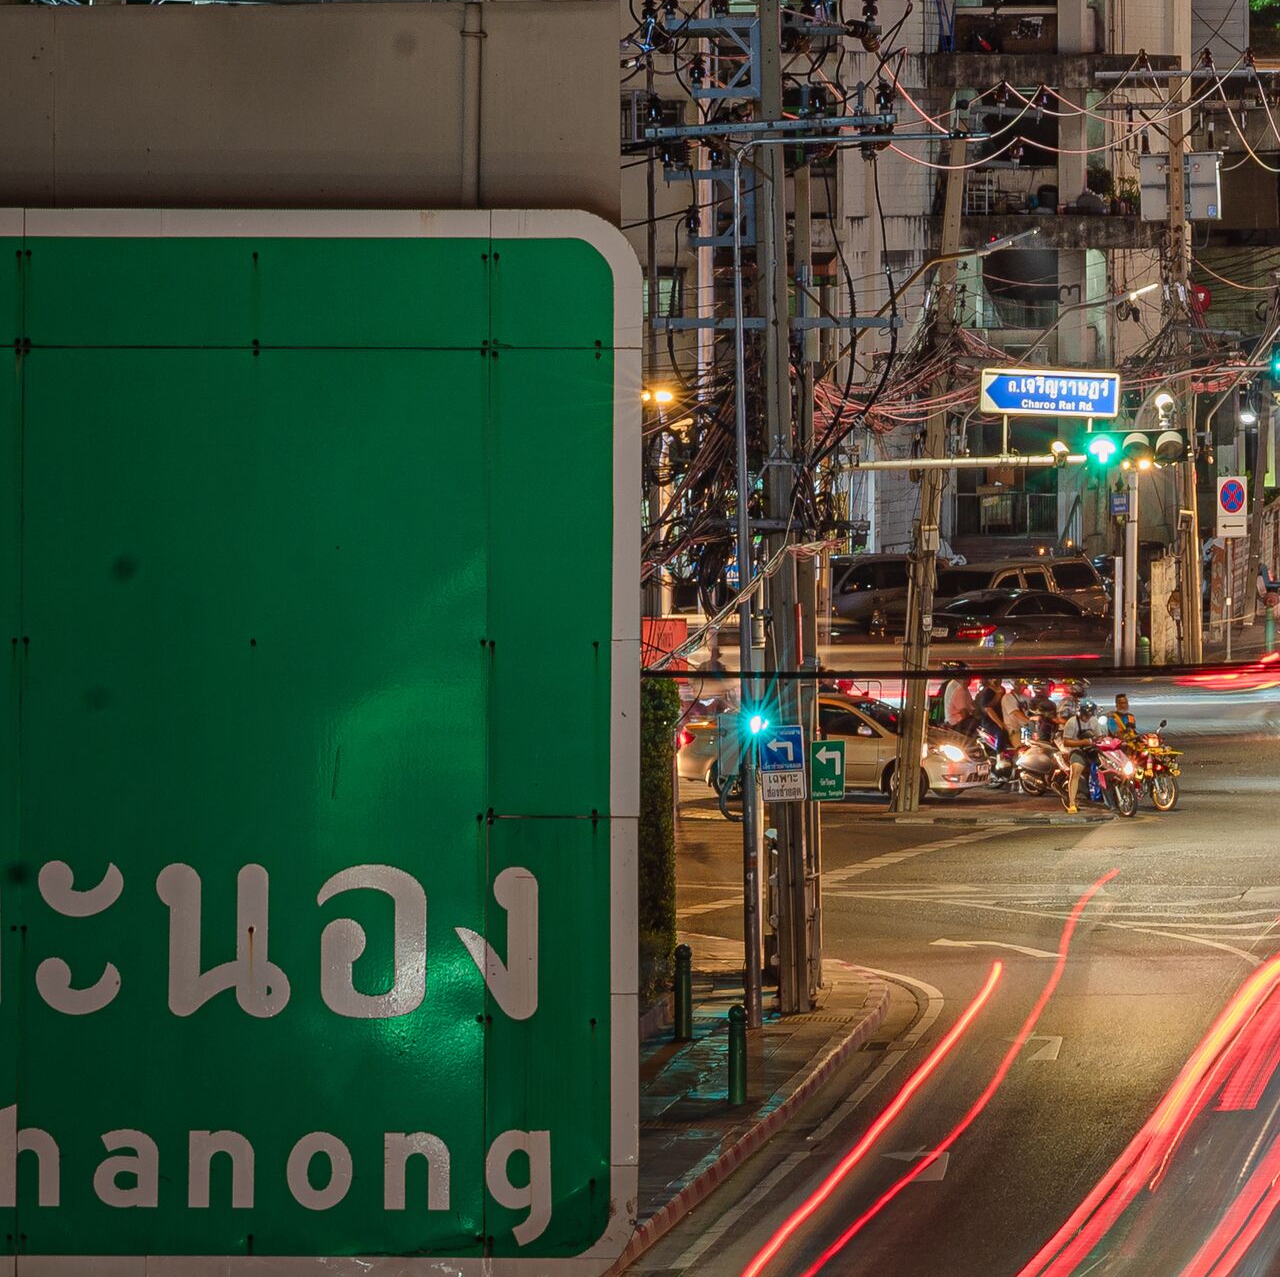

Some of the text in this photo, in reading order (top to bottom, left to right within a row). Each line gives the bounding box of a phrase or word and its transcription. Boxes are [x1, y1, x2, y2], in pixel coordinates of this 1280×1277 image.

[1058, 400, 1076, 411] Rat
[1079, 401, 1094, 411] Rd.
[768, 774, 798, 783] เฉพาะ
[35, 860, 540, 1020] ะนอง
